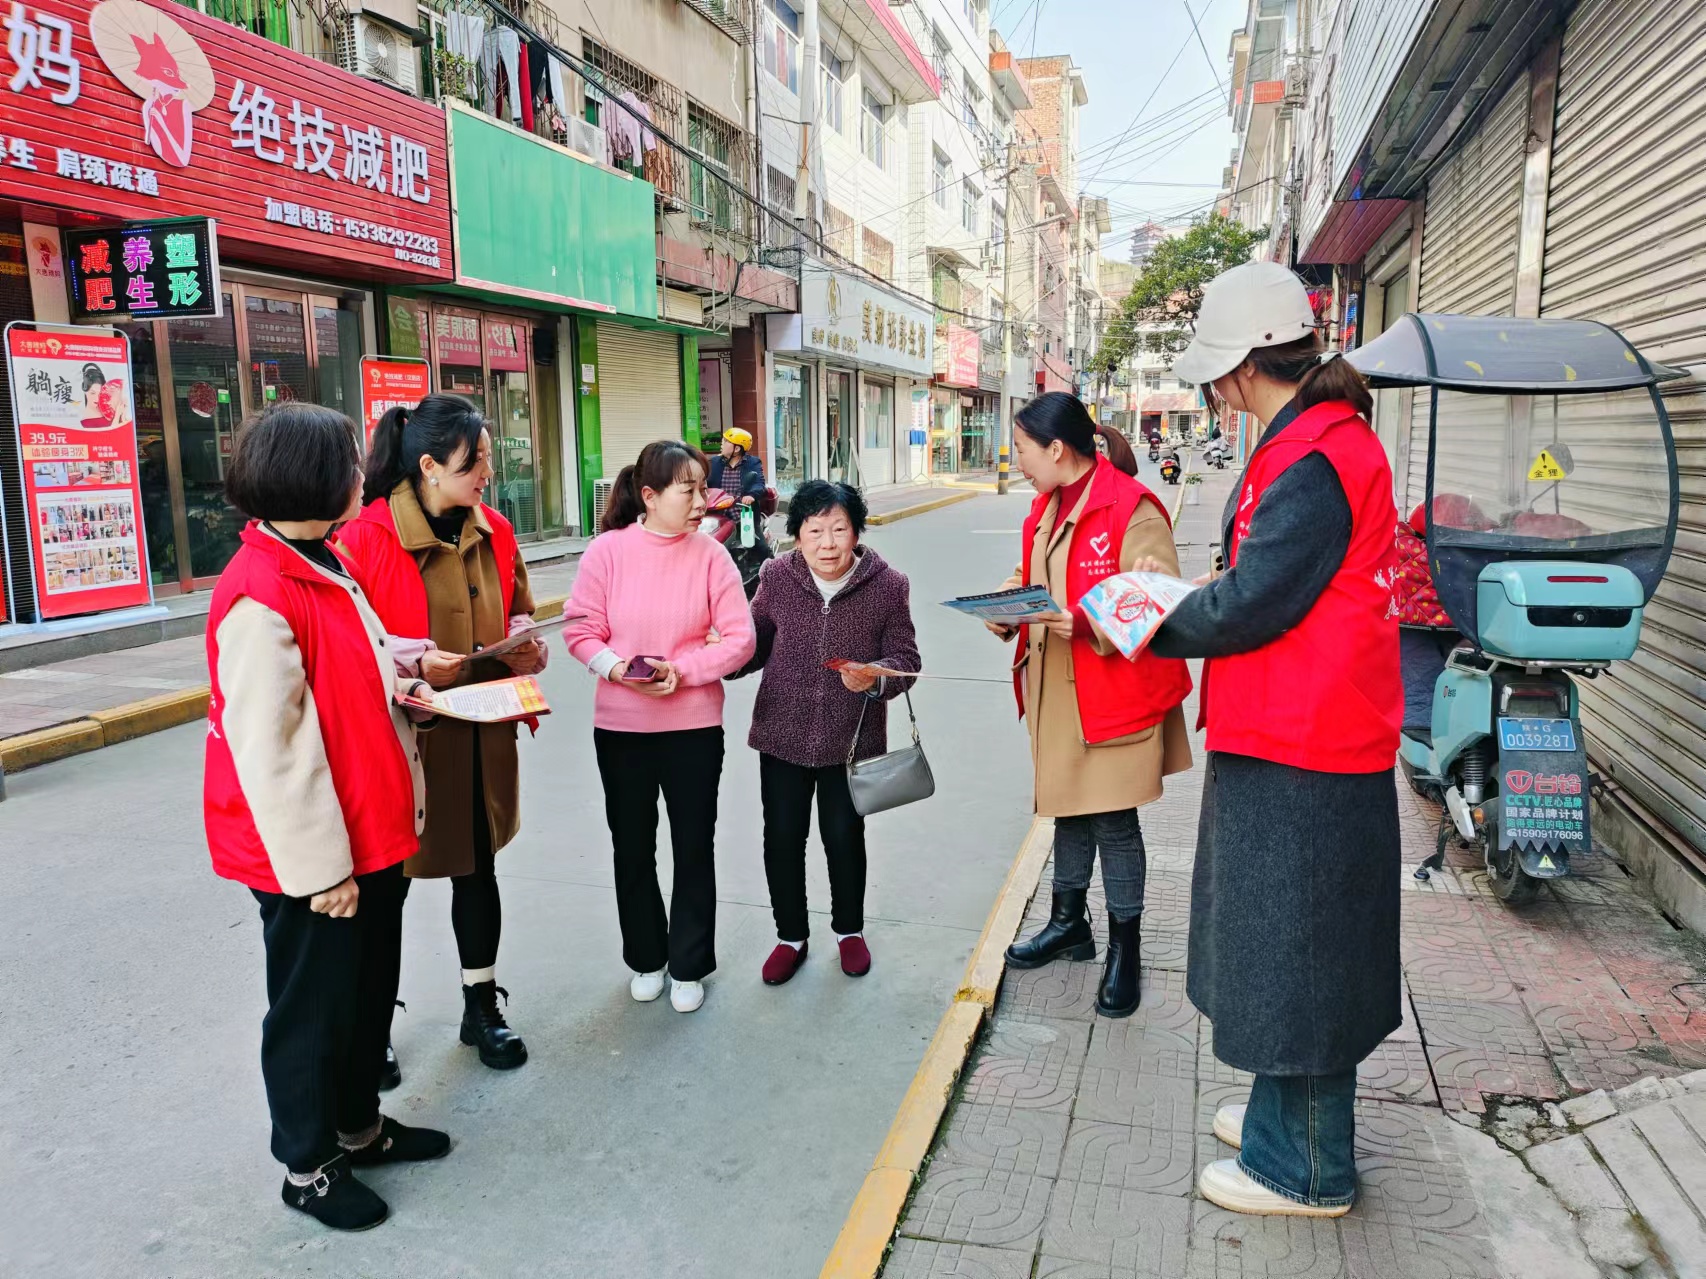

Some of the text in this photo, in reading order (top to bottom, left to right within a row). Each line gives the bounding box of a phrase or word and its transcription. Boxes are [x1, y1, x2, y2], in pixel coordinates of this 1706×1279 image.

[2, 1, 431, 204] 妈 绝技减肥
[57, 148, 160, 196] 肩颈疏通
[80, 239, 116, 311] 减肥
[122, 236, 159, 309] 养生
[164, 233, 203, 306] 塑形
[25, 367, 74, 405] 躺瘦
[29, 432, 67, 444] 39.9元
[1506, 733, 1569, 748] 0039287
[1534, 772, 1582, 795] 台铃
[1505, 806, 1584, 820] 国家品牌计划
[1506, 818, 1584, 830] 跑得更远的电动车
[1516, 829, 1584, 840] 15909176096
